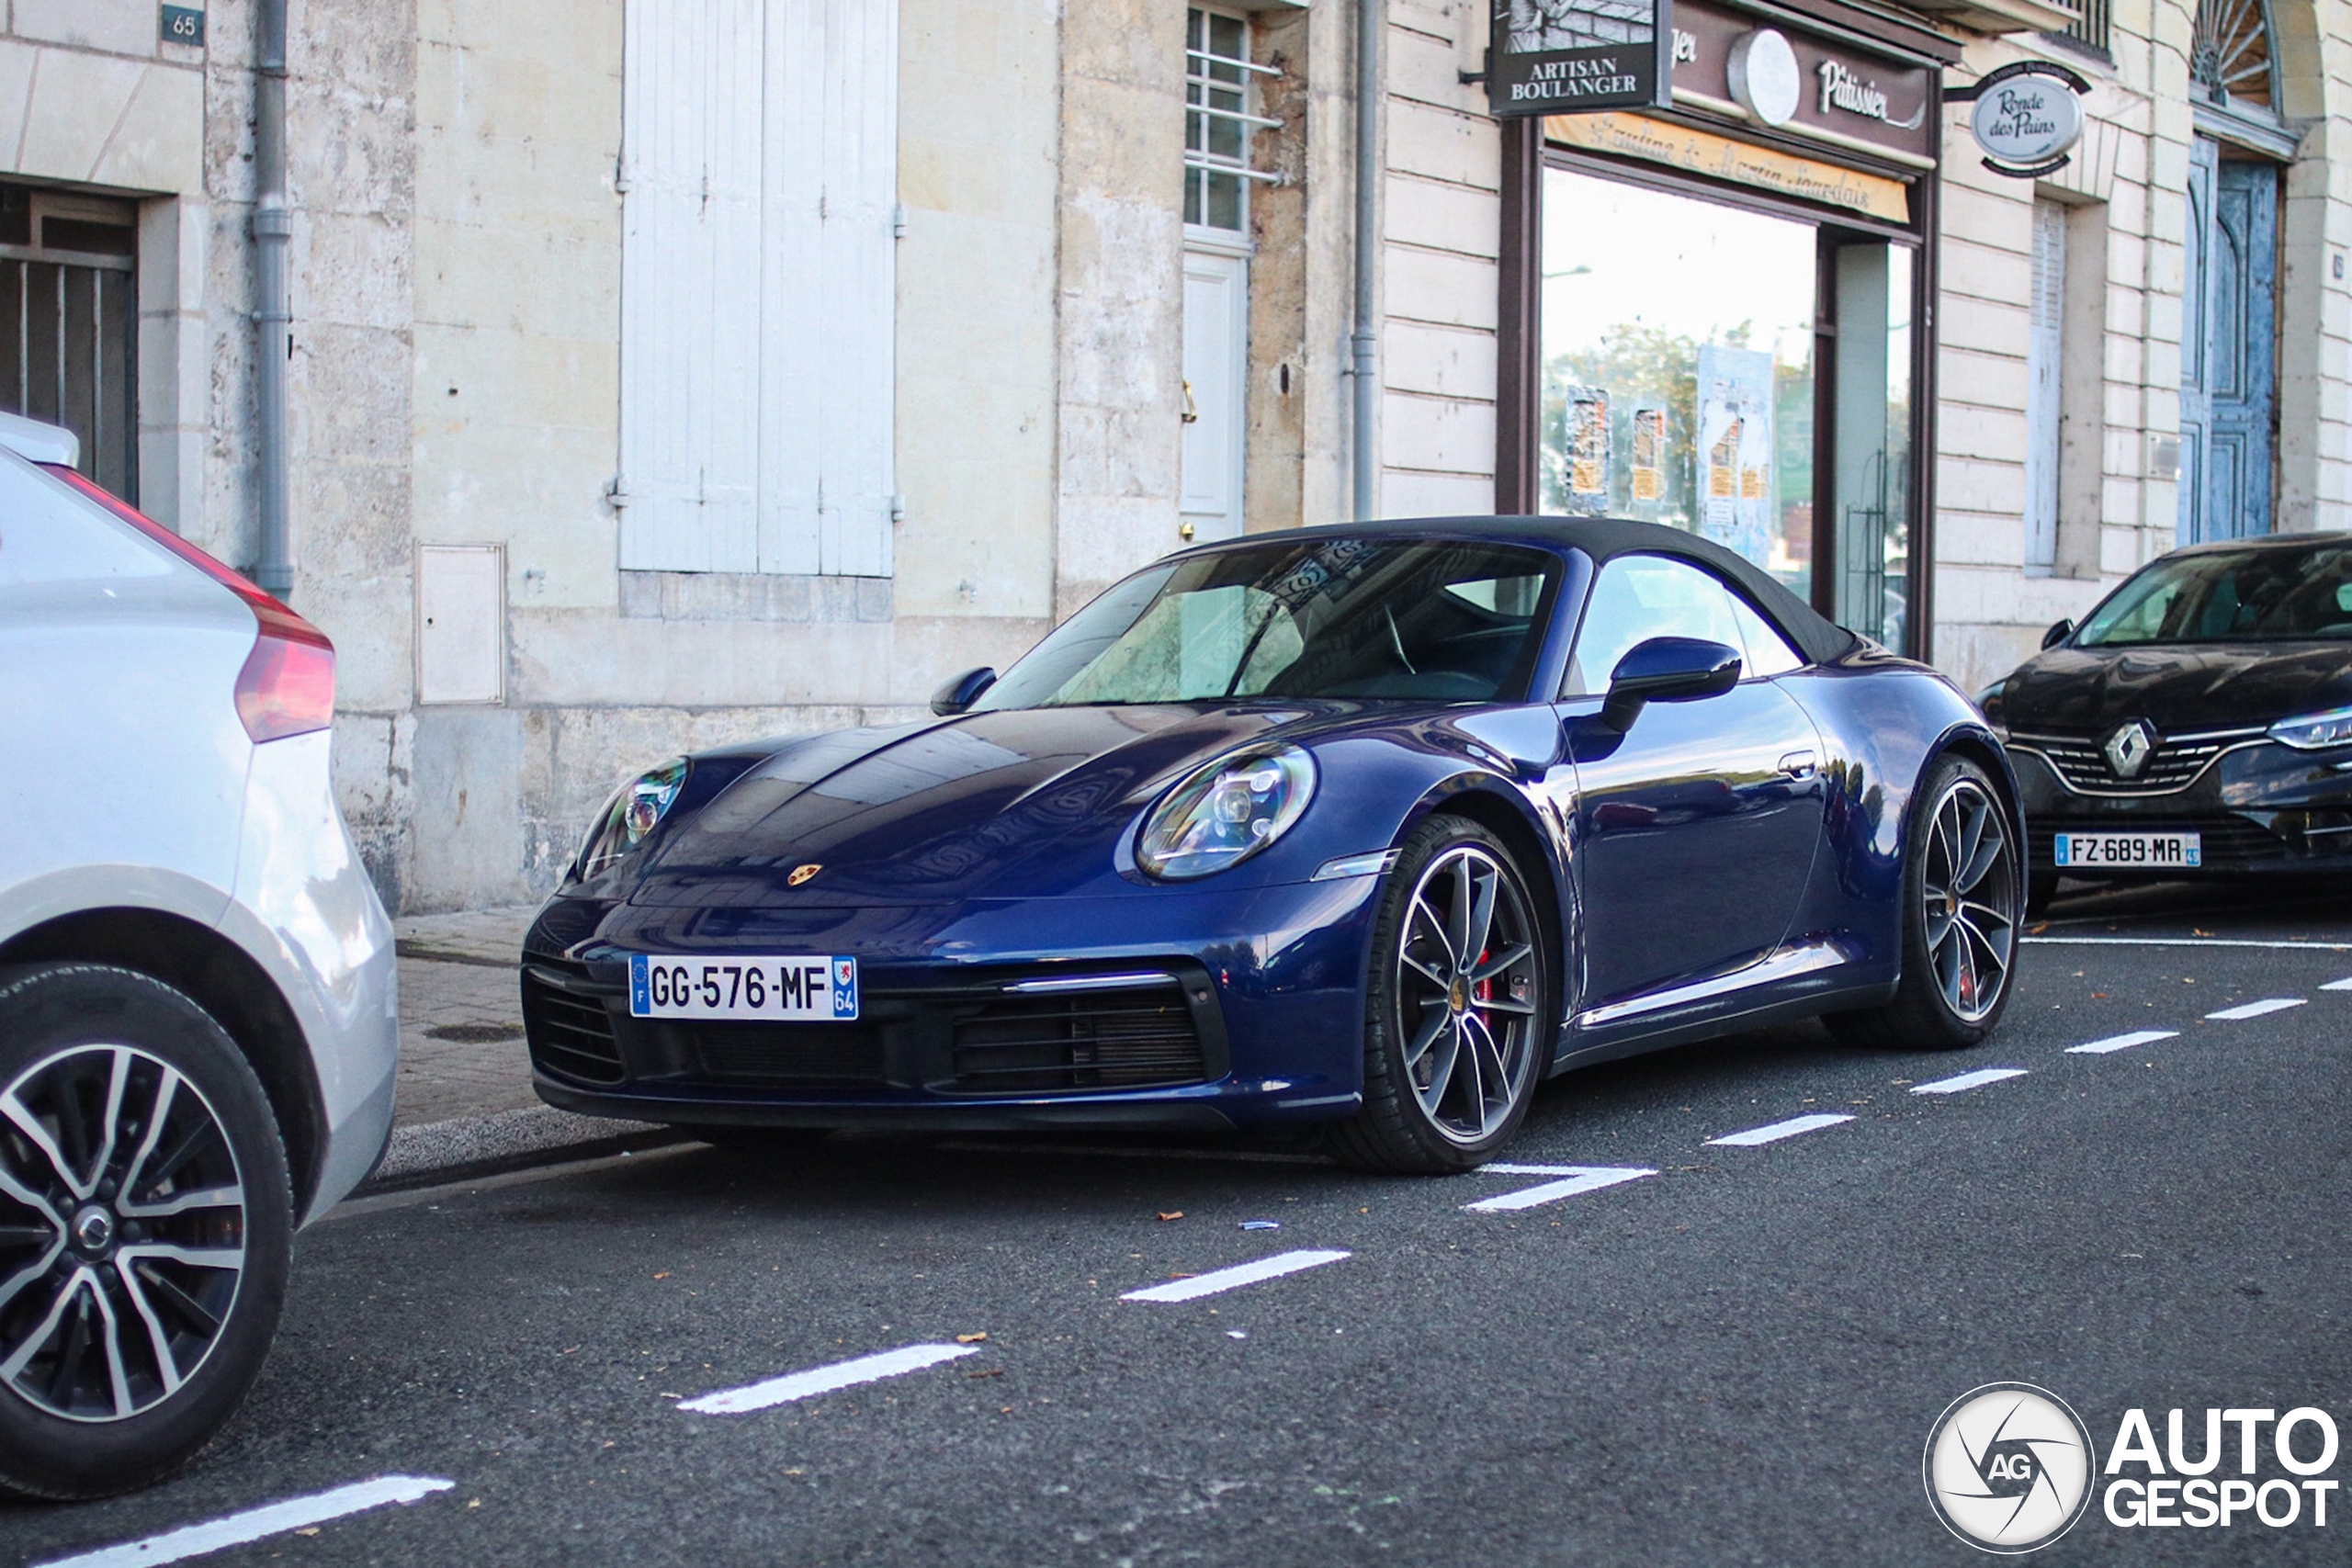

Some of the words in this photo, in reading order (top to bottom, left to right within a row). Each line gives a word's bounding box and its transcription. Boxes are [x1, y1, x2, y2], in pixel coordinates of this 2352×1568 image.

[173, 14, 196, 37] 65
[1529, 58, 1617, 81] ARTISAN
[1510, 74, 1636, 101] BOULANGER
[1817, 59, 1908, 127] Pâtissier
[1997, 89, 2044, 115] Ronde
[1989, 119, 2013, 137] des
[2012, 111, 2055, 138] Pains
[2072, 838, 2181, 862] FZ-689-MR
[637, 989, 644, 1003] F
[651, 965, 826, 1010] GG-576-MF
[834, 990, 854, 1011] 64
